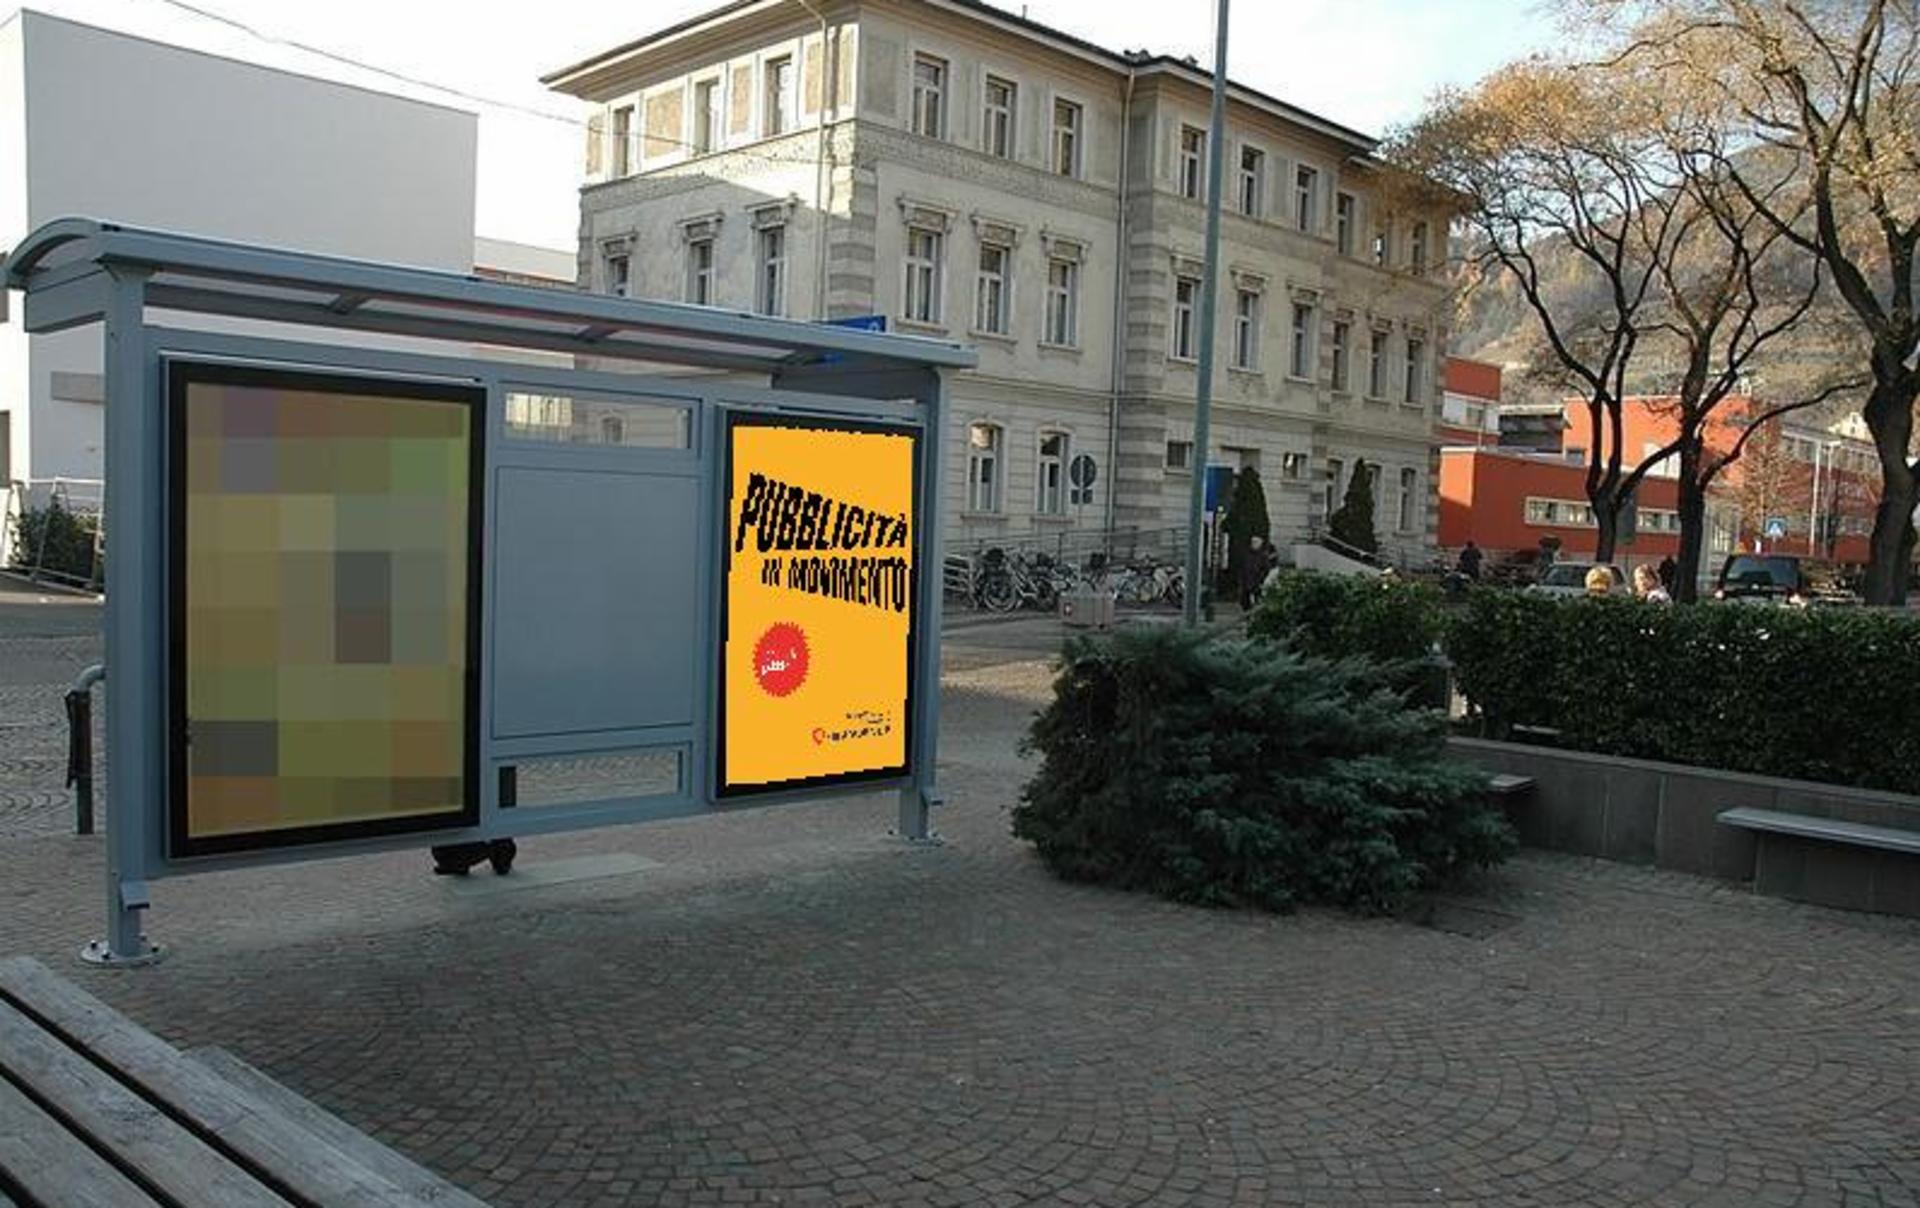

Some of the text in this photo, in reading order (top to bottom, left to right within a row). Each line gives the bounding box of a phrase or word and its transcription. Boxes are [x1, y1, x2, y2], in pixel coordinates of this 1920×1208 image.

[735, 472, 908, 553] PUBBLICITÀ
[761, 556, 908, 613] IN MOVIMENTO
